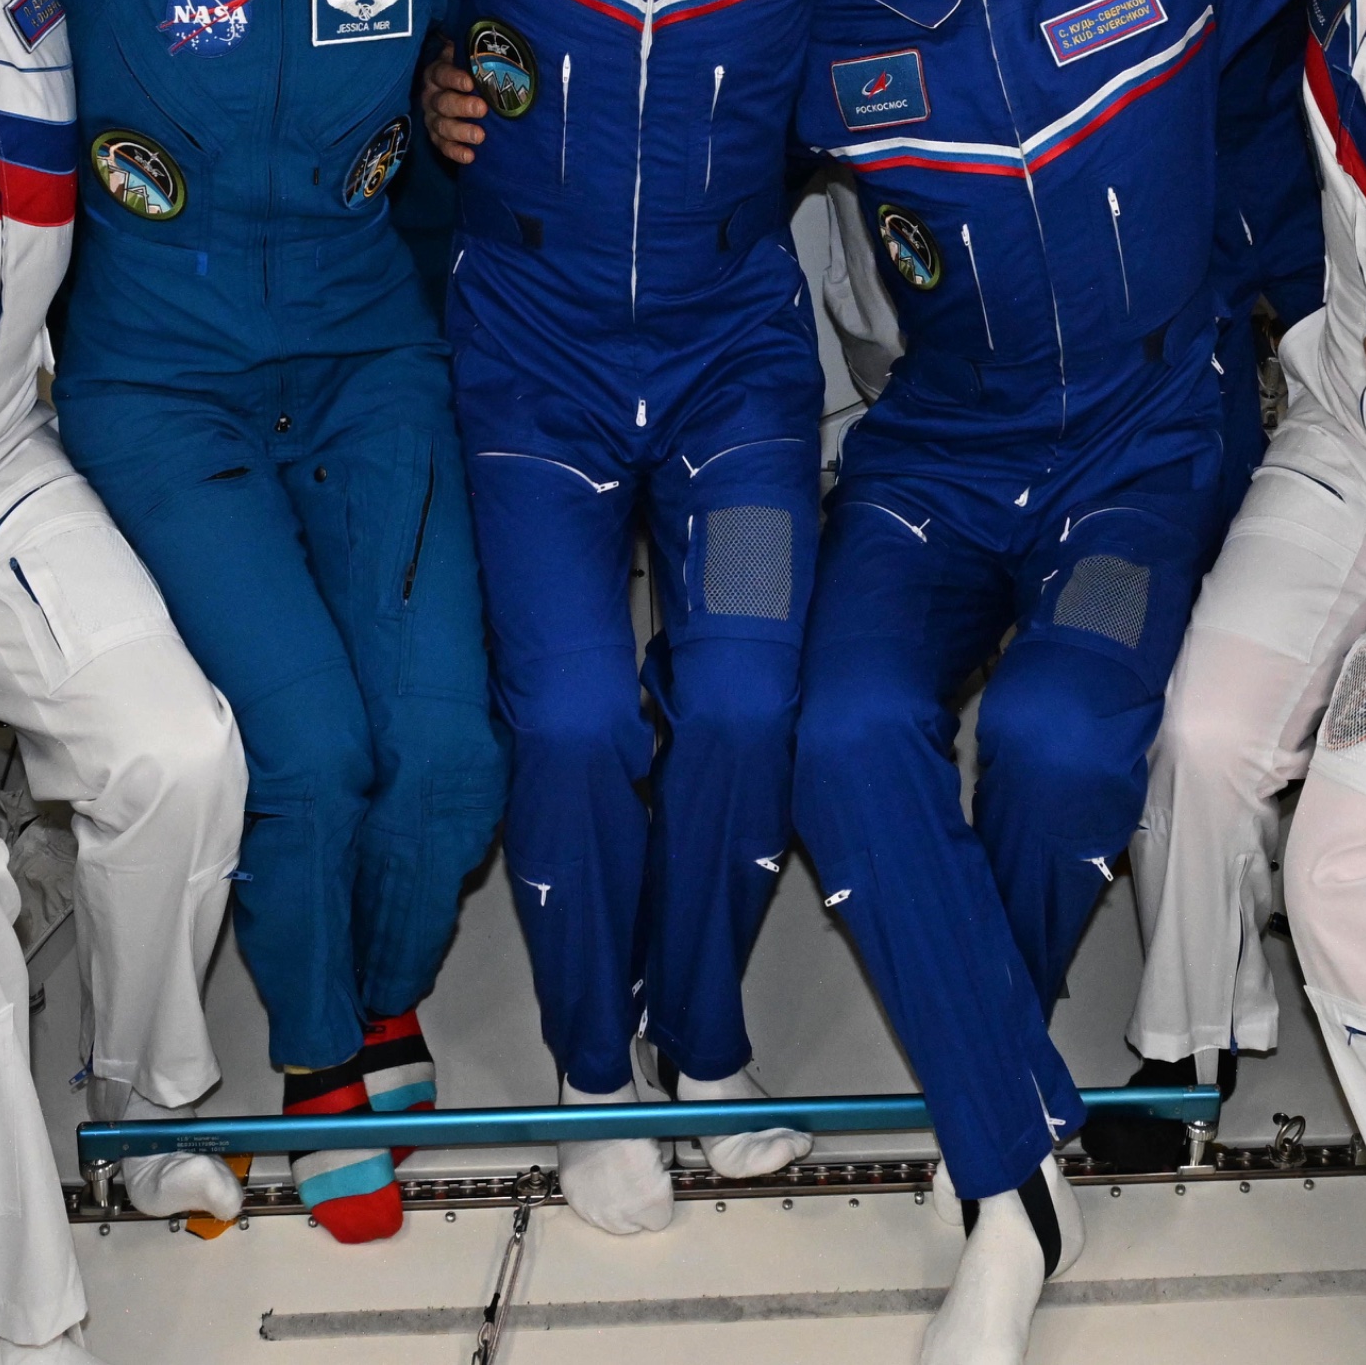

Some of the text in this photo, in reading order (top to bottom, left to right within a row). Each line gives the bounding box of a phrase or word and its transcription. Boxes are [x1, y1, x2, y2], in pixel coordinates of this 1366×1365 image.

[173, 5, 249, 25] NASA
[336, 21, 370, 35] JESSICA
[1062, 5, 1152, 50] S. KUD-SVERCHKOV
[855, 98, 909, 115] РОСКОСМОС
